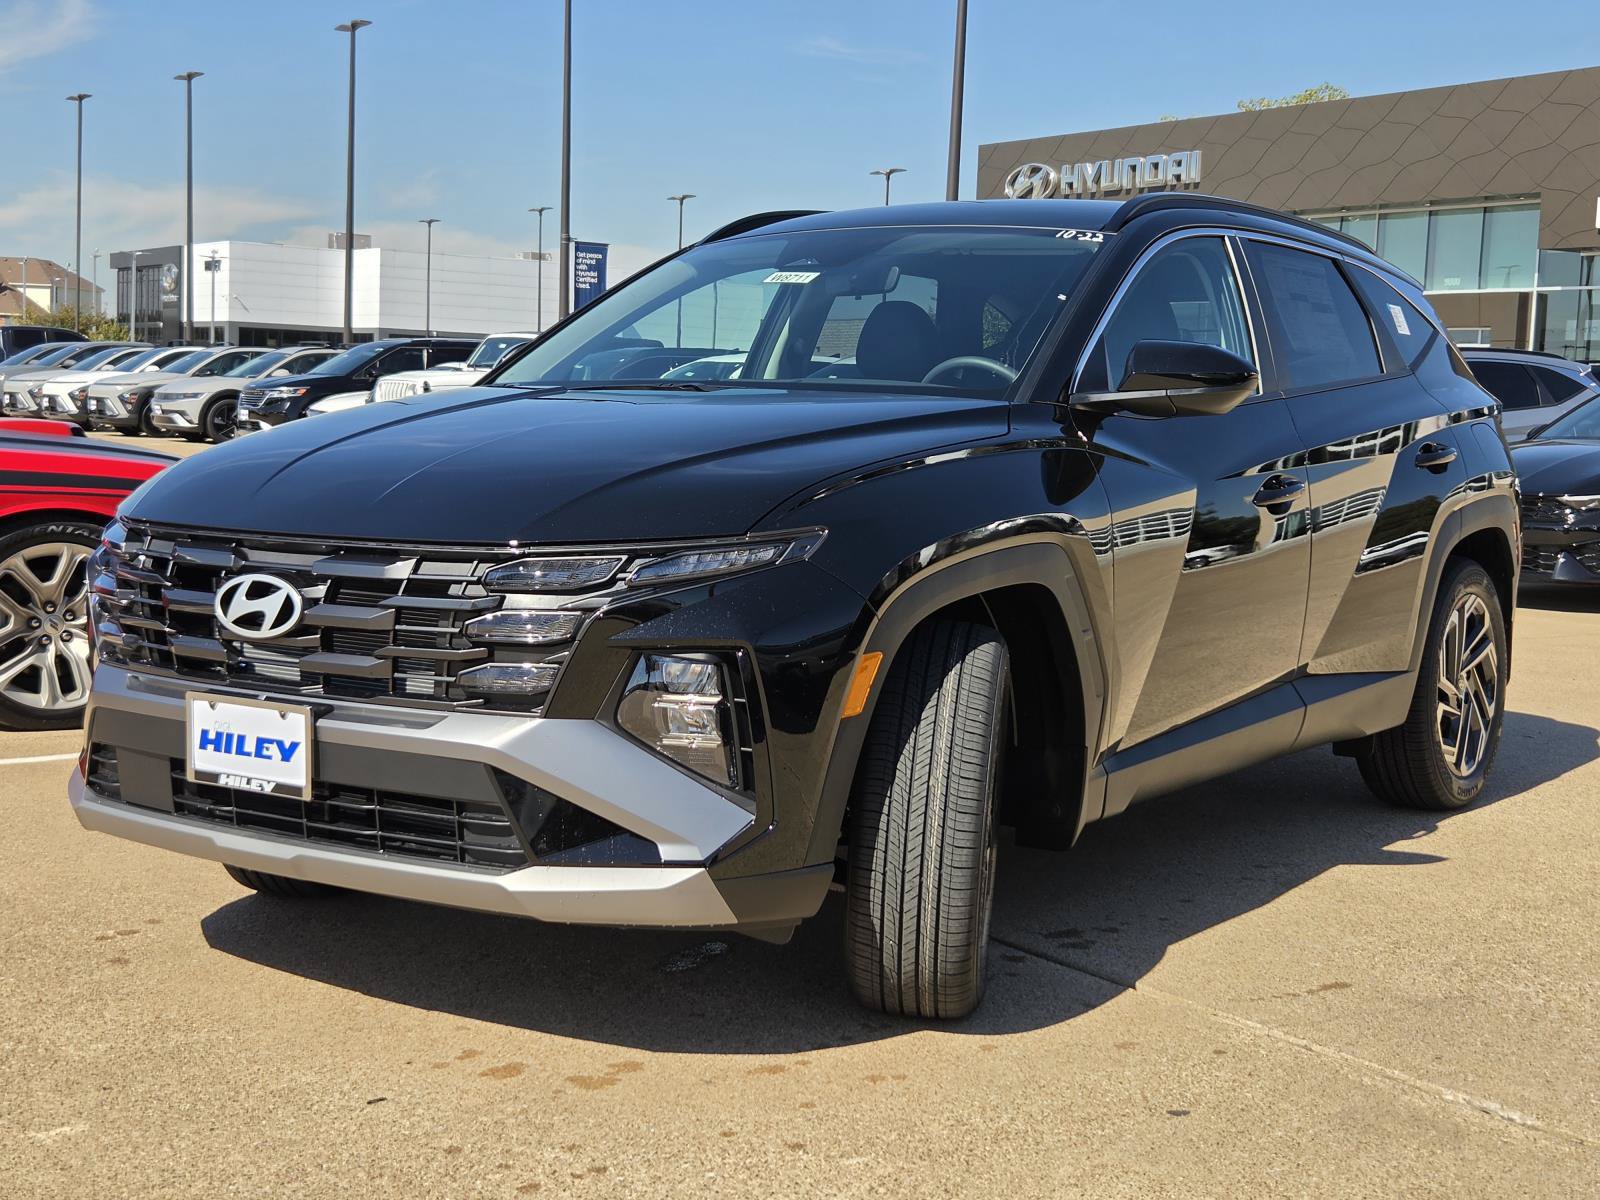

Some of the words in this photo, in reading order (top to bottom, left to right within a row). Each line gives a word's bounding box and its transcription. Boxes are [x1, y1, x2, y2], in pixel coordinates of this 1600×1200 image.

[1060, 150, 1202, 195] HYUNDAI
[1055, 230, 1104, 243] 10-22
[199, 728, 301, 762] HILEY
[219, 774, 277, 792] HILEY
